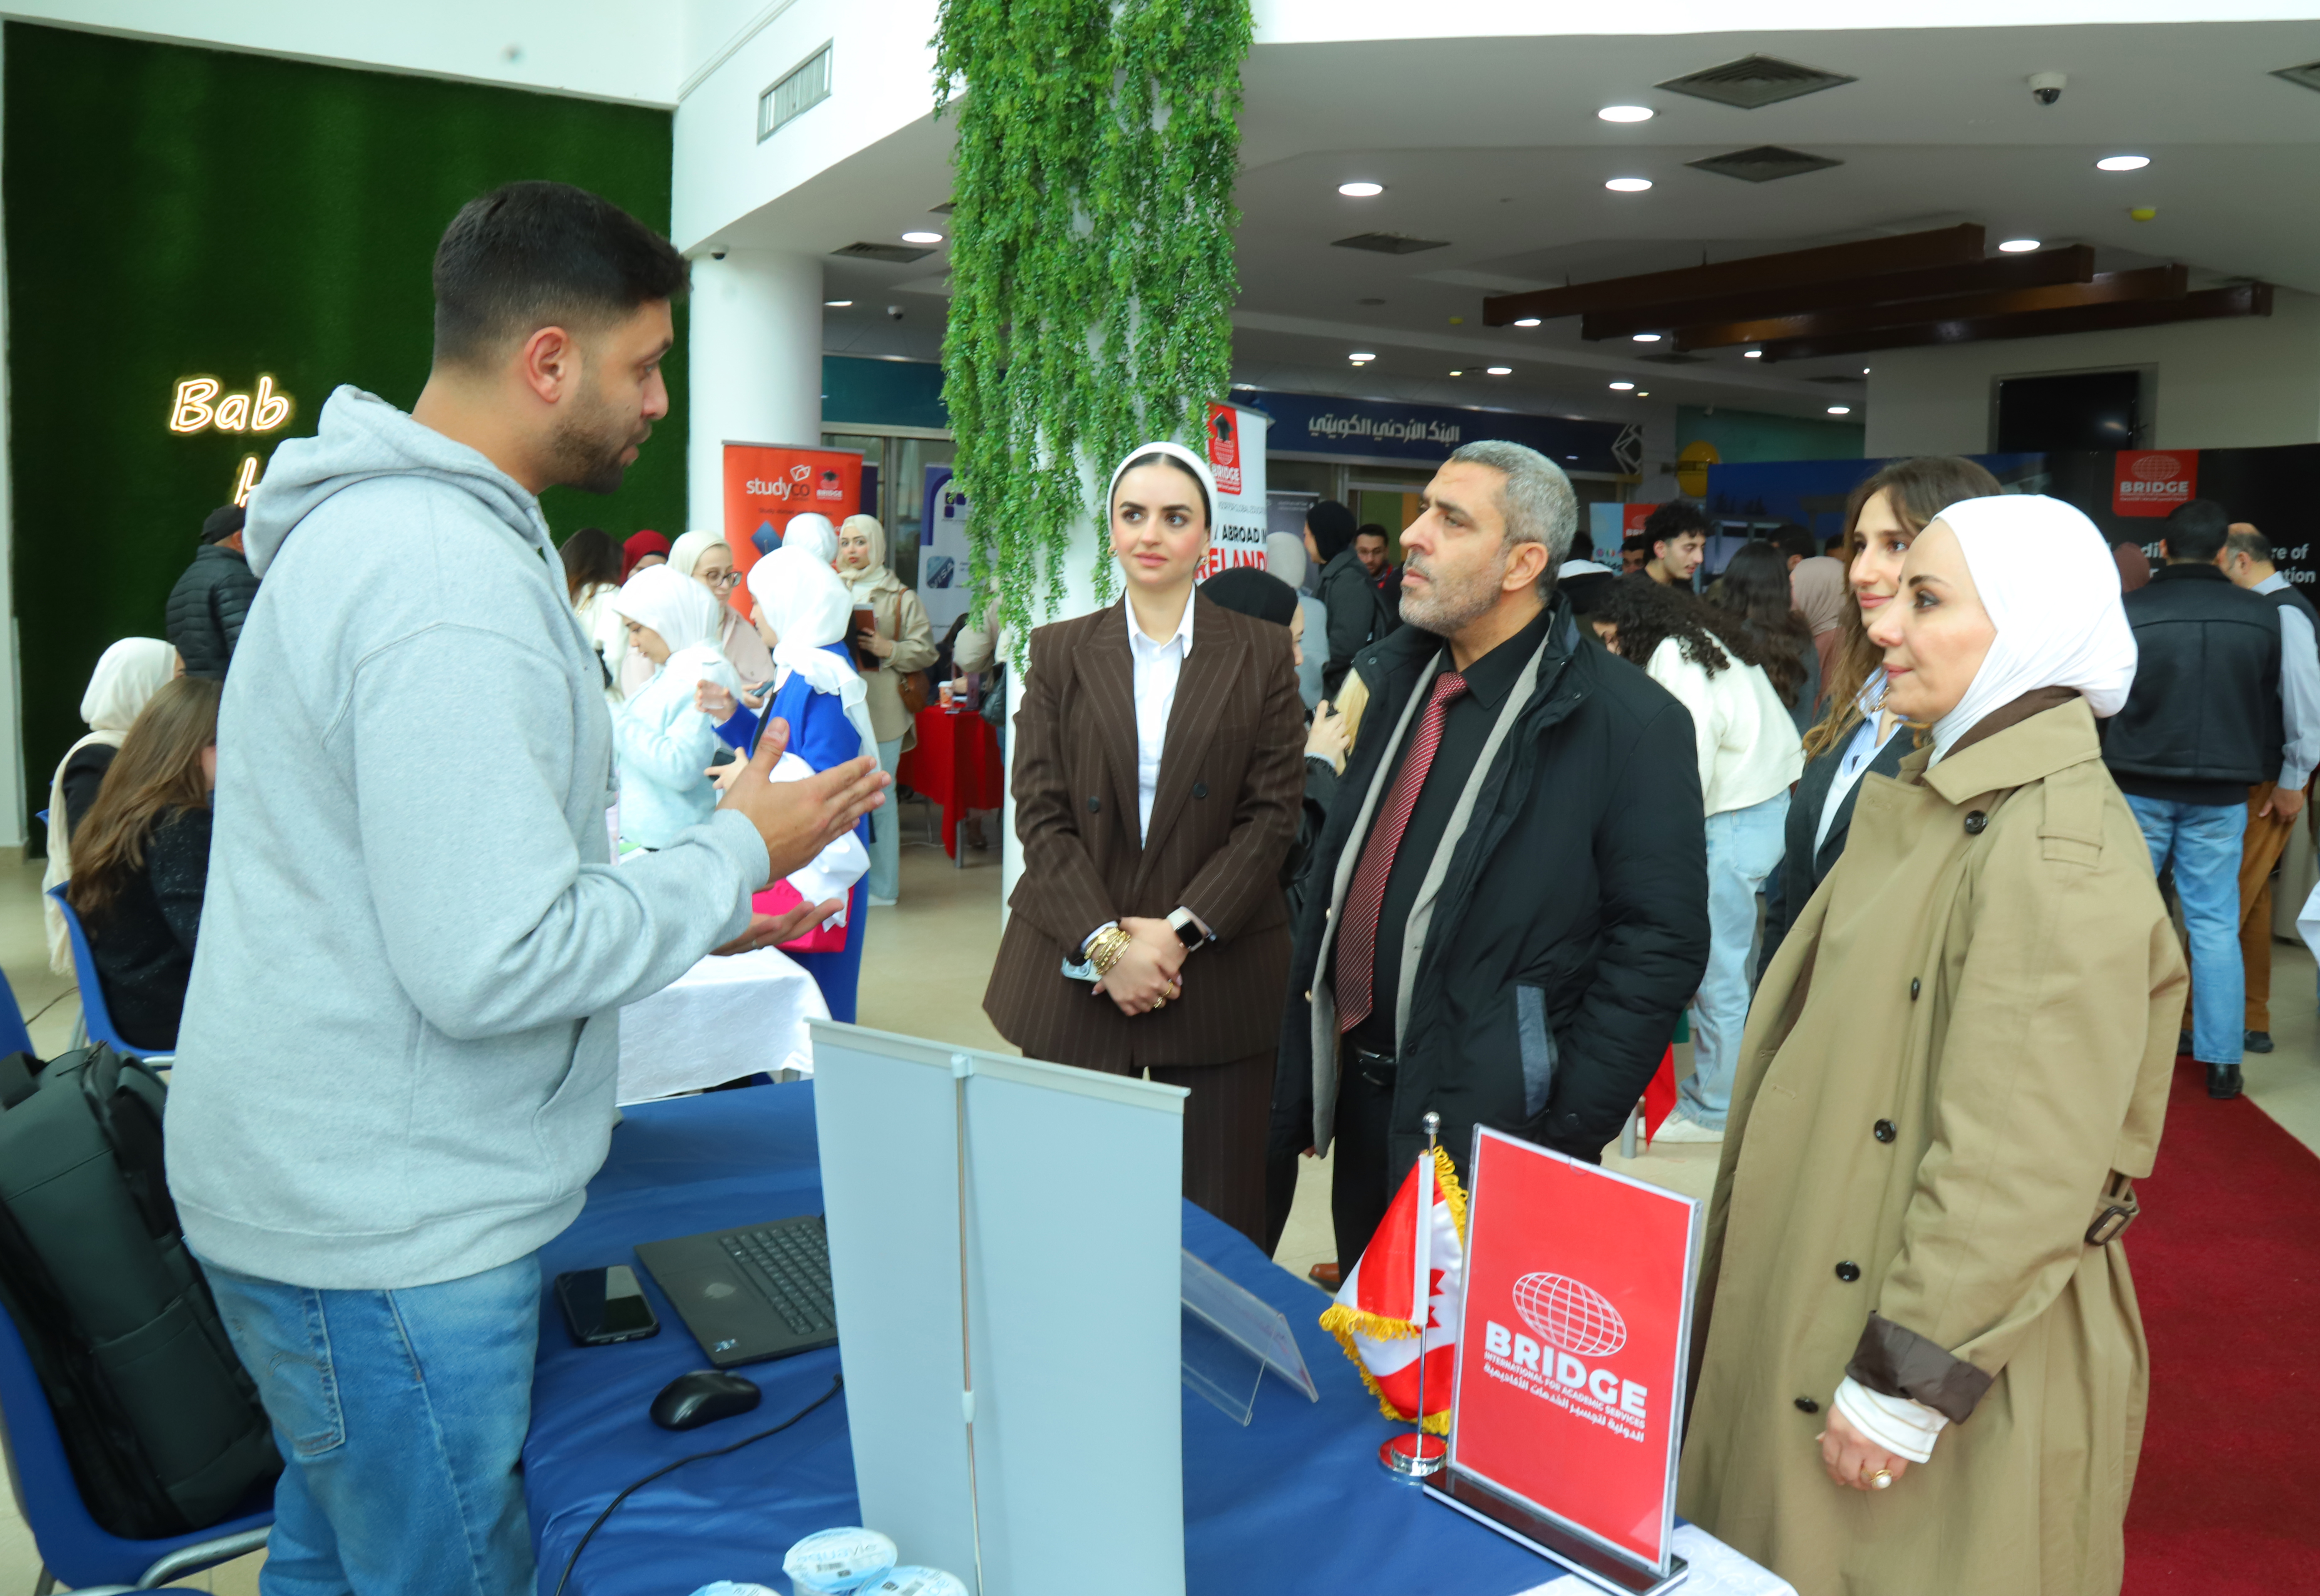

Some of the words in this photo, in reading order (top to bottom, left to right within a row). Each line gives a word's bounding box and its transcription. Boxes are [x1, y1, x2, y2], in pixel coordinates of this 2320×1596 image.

[170, 376, 289, 432] Bab
[1309, 413, 1372, 439] الكويتي
[1372, 419, 1427, 444] الأردني
[1427, 420, 1461, 447] البنك
[1211, 462, 1240, 482] BRIDGE
[2120, 481, 2189, 493] BRIDGE
[1222, 524, 1259, 543] ABROAD
[2271, 547, 2288, 560] re
[2290, 543, 2310, 560] of
[928, 562, 955, 588] VISA
[2283, 566, 2316, 584] tion
[1484, 1320, 1648, 1419] BRIDGE
[1483, 1351, 1544, 1385] INTERNATIONAL
[1544, 1377, 1561, 1392] FOR
[1561, 1386, 1605, 1412] ACADEMIC
[1604, 1405, 1646, 1430] SERVICES
[1529, 1383, 1570, 1409] الخدمات
[1607, 1417, 1645, 1443] الدولية
